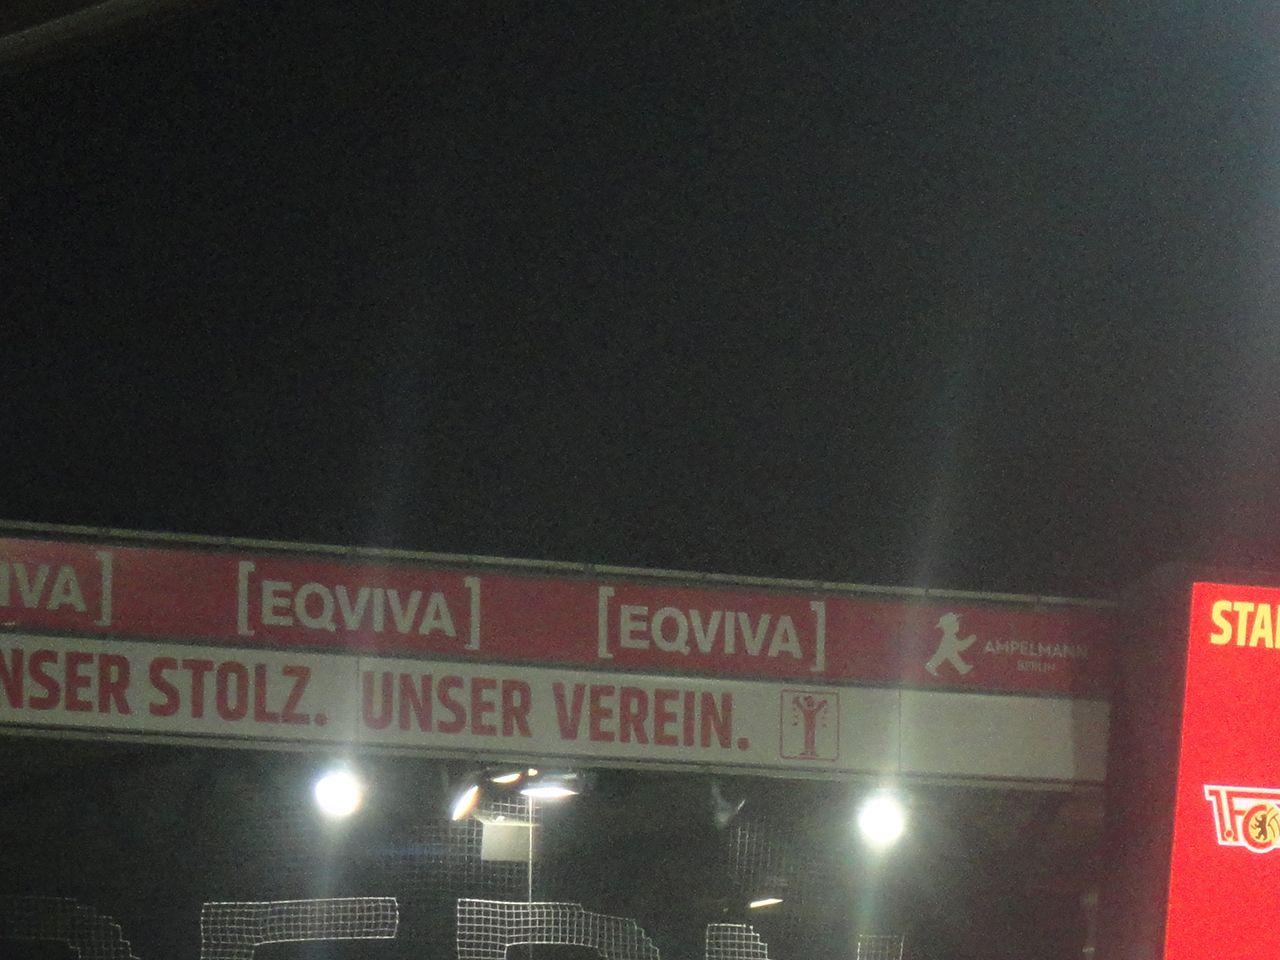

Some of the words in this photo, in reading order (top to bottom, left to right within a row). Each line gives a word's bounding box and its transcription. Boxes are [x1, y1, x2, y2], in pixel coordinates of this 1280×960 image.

[148, 657, 328, 726] STOLZ.
[362, 671, 533, 738] UNSER
[553, 682, 750, 751] VEREIN.
